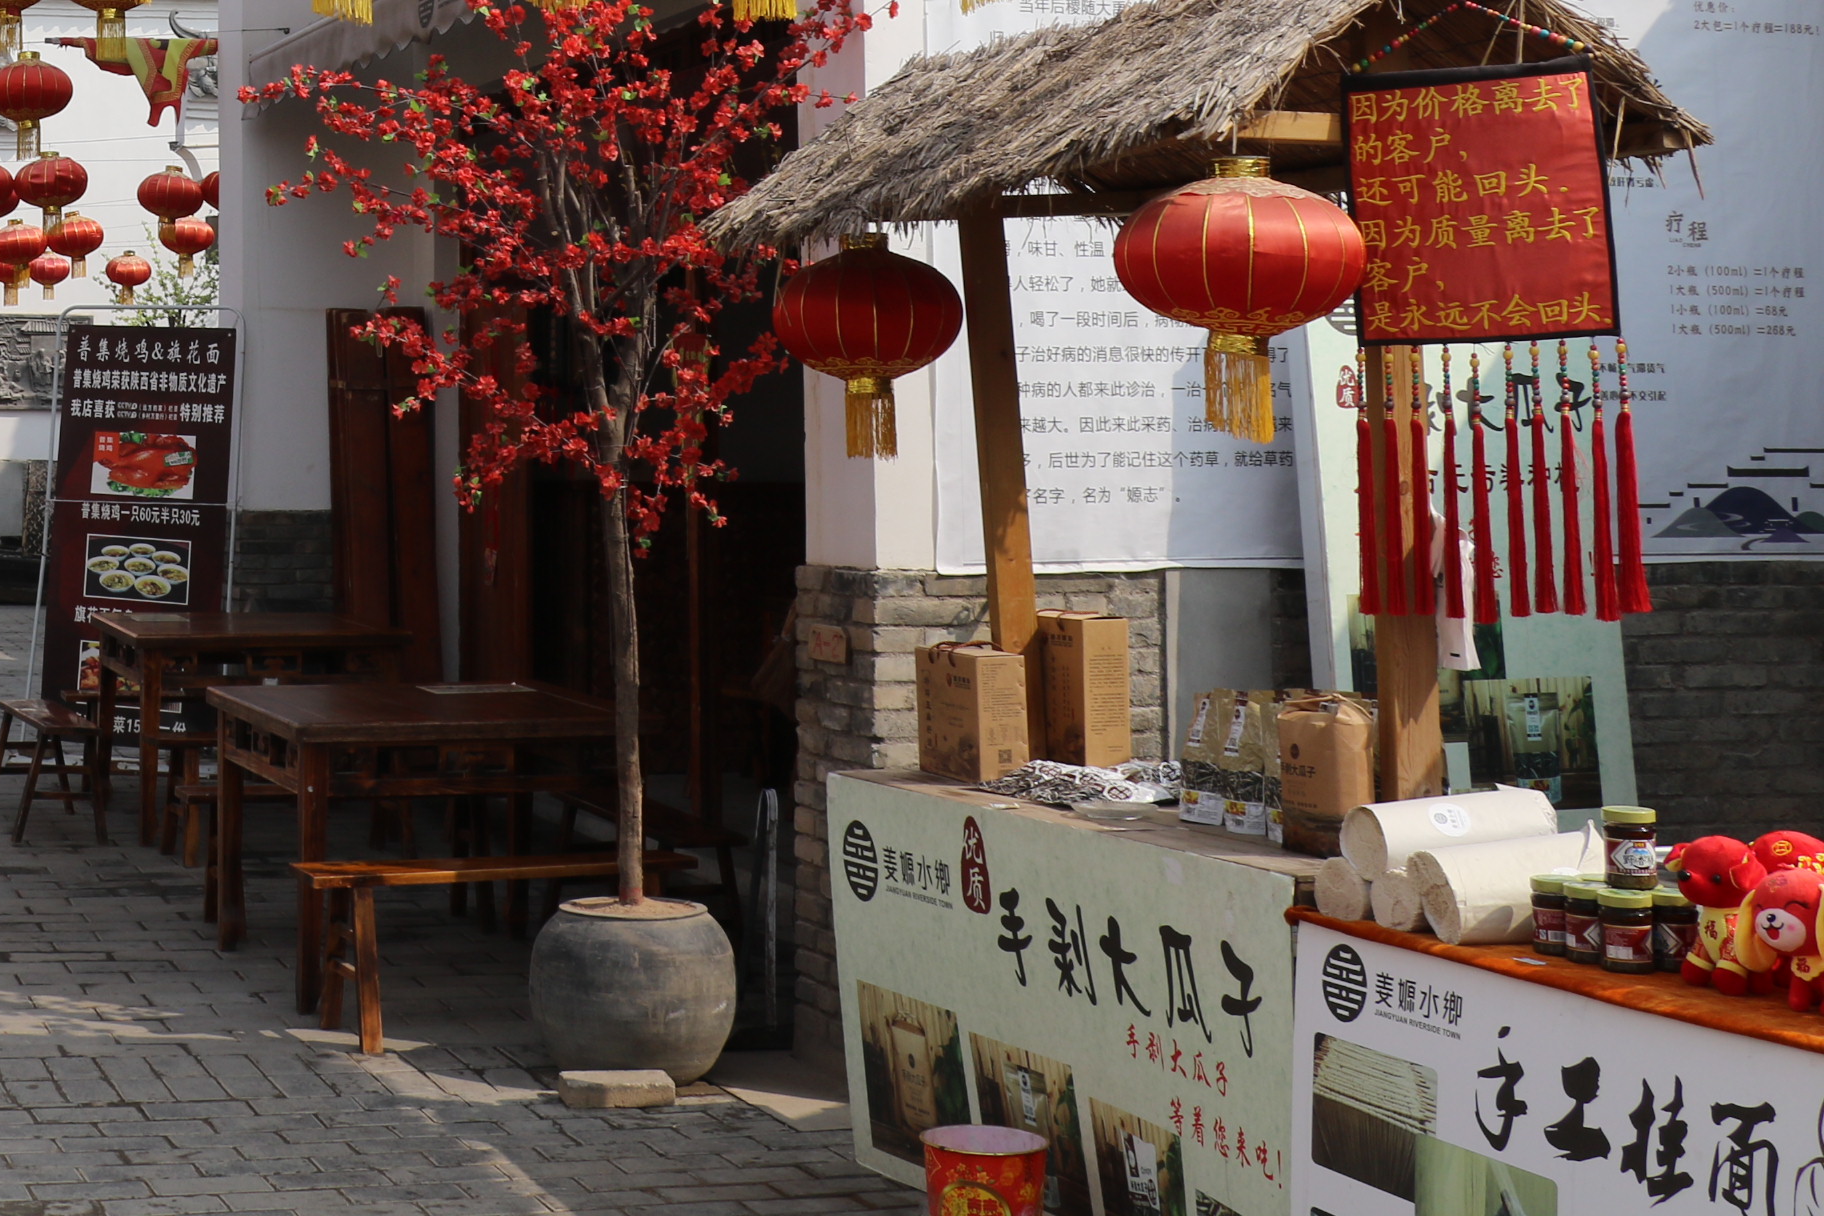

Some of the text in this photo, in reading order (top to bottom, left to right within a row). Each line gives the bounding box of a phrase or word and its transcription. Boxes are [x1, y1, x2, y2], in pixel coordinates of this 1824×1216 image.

[1351, 78, 1583, 124] 因为价格离去了
[1360, 207, 1600, 250] 因为质量离去了
[1665, 210, 1709, 242] 疗程
[77, 335, 220, 365] 普集烧鸡&旗花面
[73, 368, 227, 394] 普集烧鸡荣获陕西省非物质文化遗产
[71, 399, 225, 424] 我店喜获 特别推荐
[81, 502, 200, 527] 普集烧鸡一只60元半只30元
[962, 826, 987, 911] 优质
[912, 891, 938, 907] RIVERSIDE
[938, 898, 954, 910] TOWN
[998, 887, 1263, 1058] 手剥大瓜子
[1374, 1008, 1462, 1041] JIANGYUAN RIVERSIDE TOWN
[1125, 1023, 1229, 1097] 手剥大瓜子
